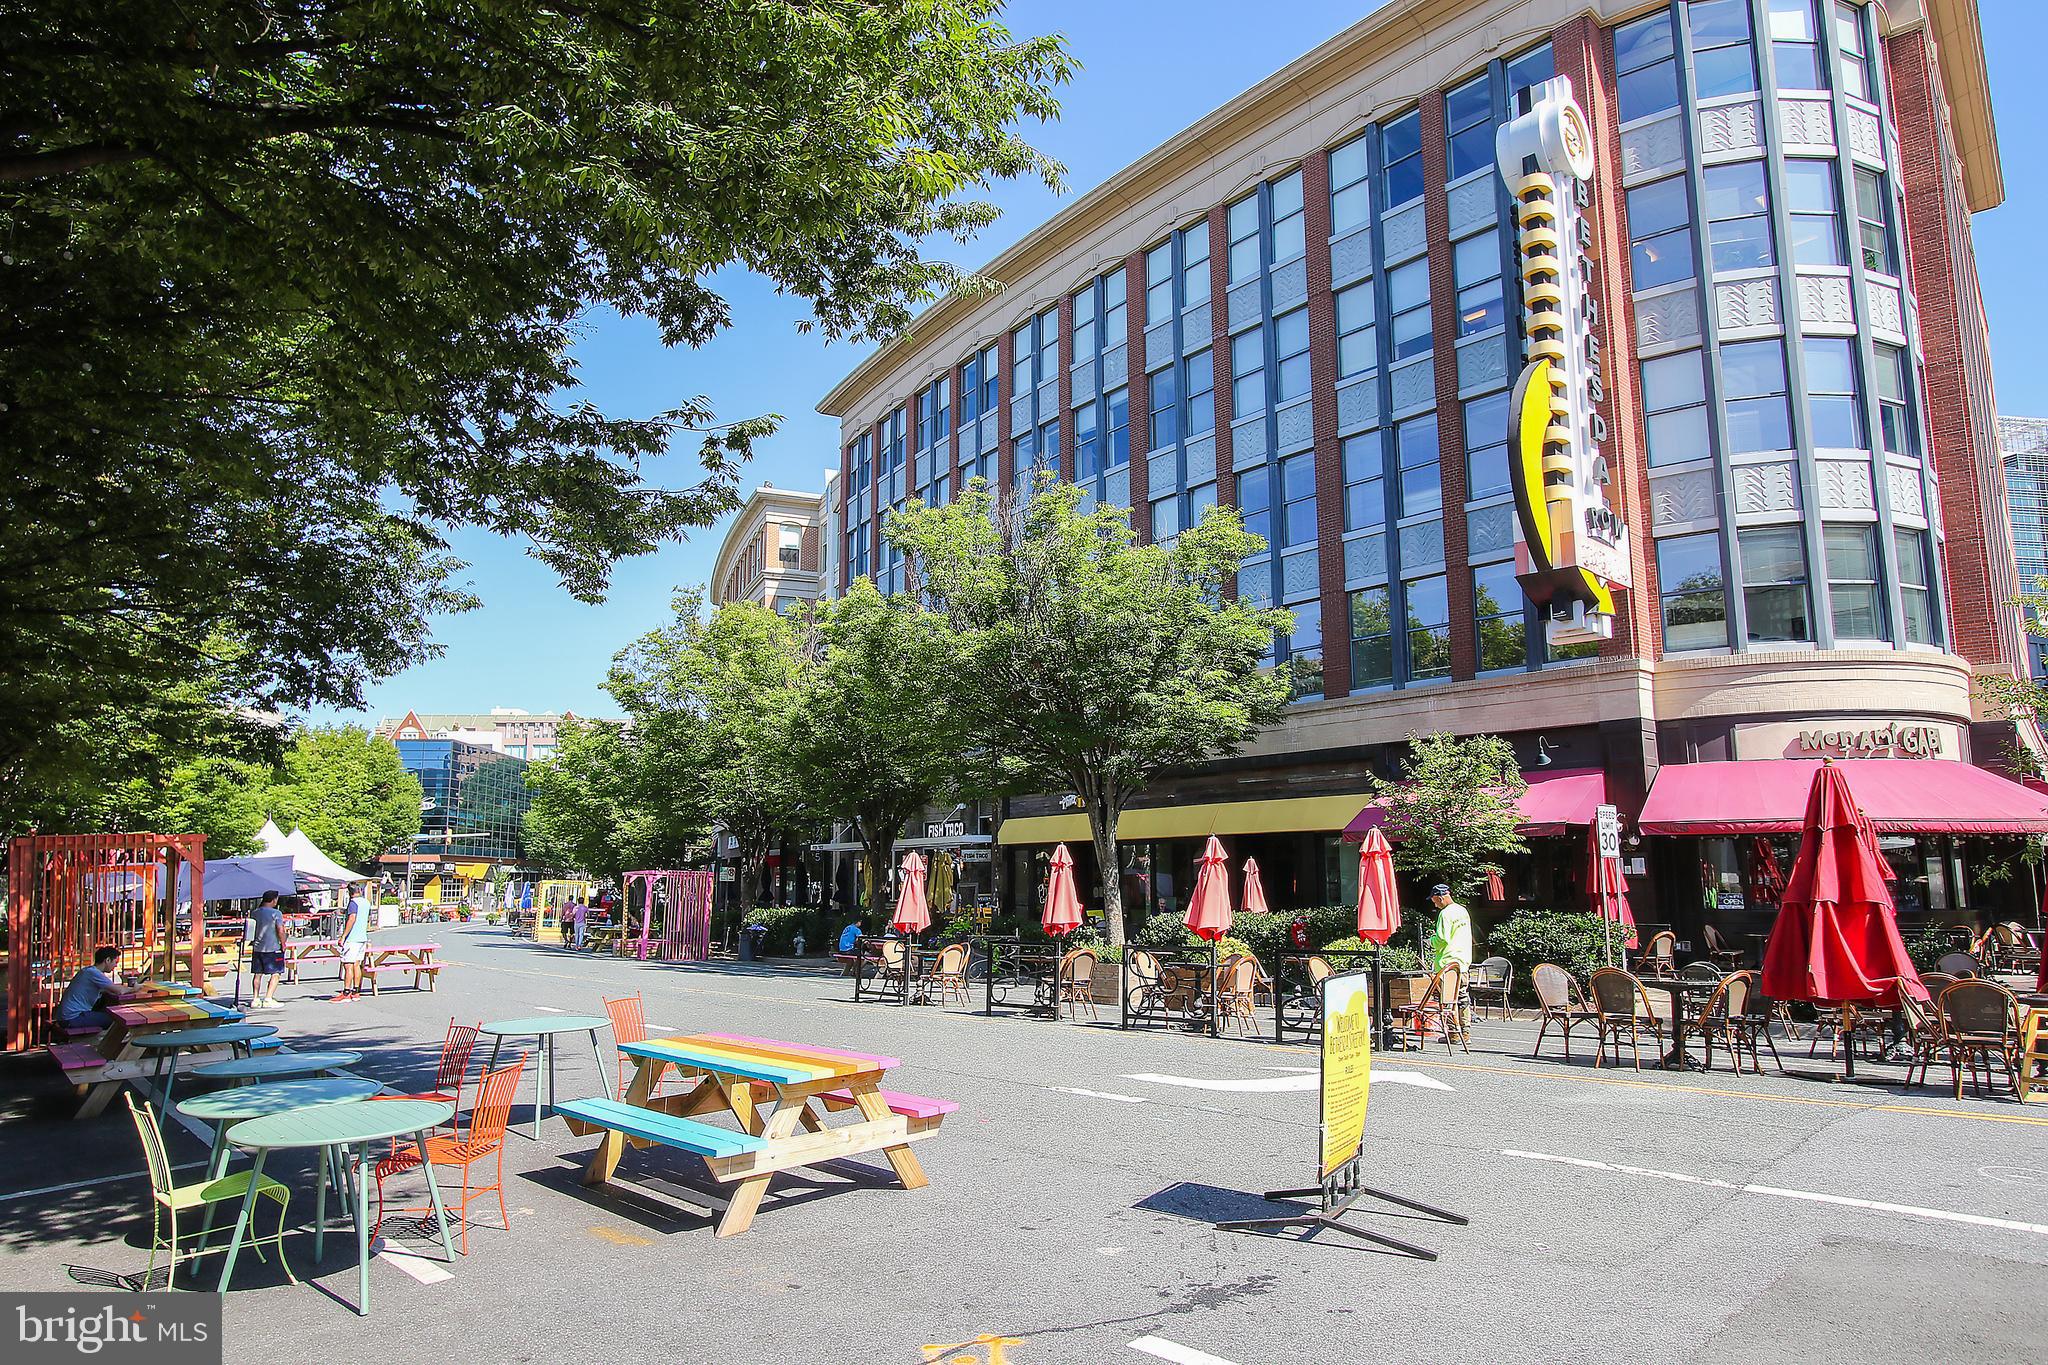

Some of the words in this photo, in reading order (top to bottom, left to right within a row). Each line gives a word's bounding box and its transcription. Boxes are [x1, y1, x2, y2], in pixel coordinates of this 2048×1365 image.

[1573, 177, 1611, 486] BETHESDA
[1586, 507, 1624, 541] ROW
[1599, 810, 1615, 819] SPEED
[928, 823, 944, 838] FISH
[945, 822, 964, 837] TACO
[1601, 822, 1614, 831] LIMIT
[1602, 833, 1617, 851] 30
